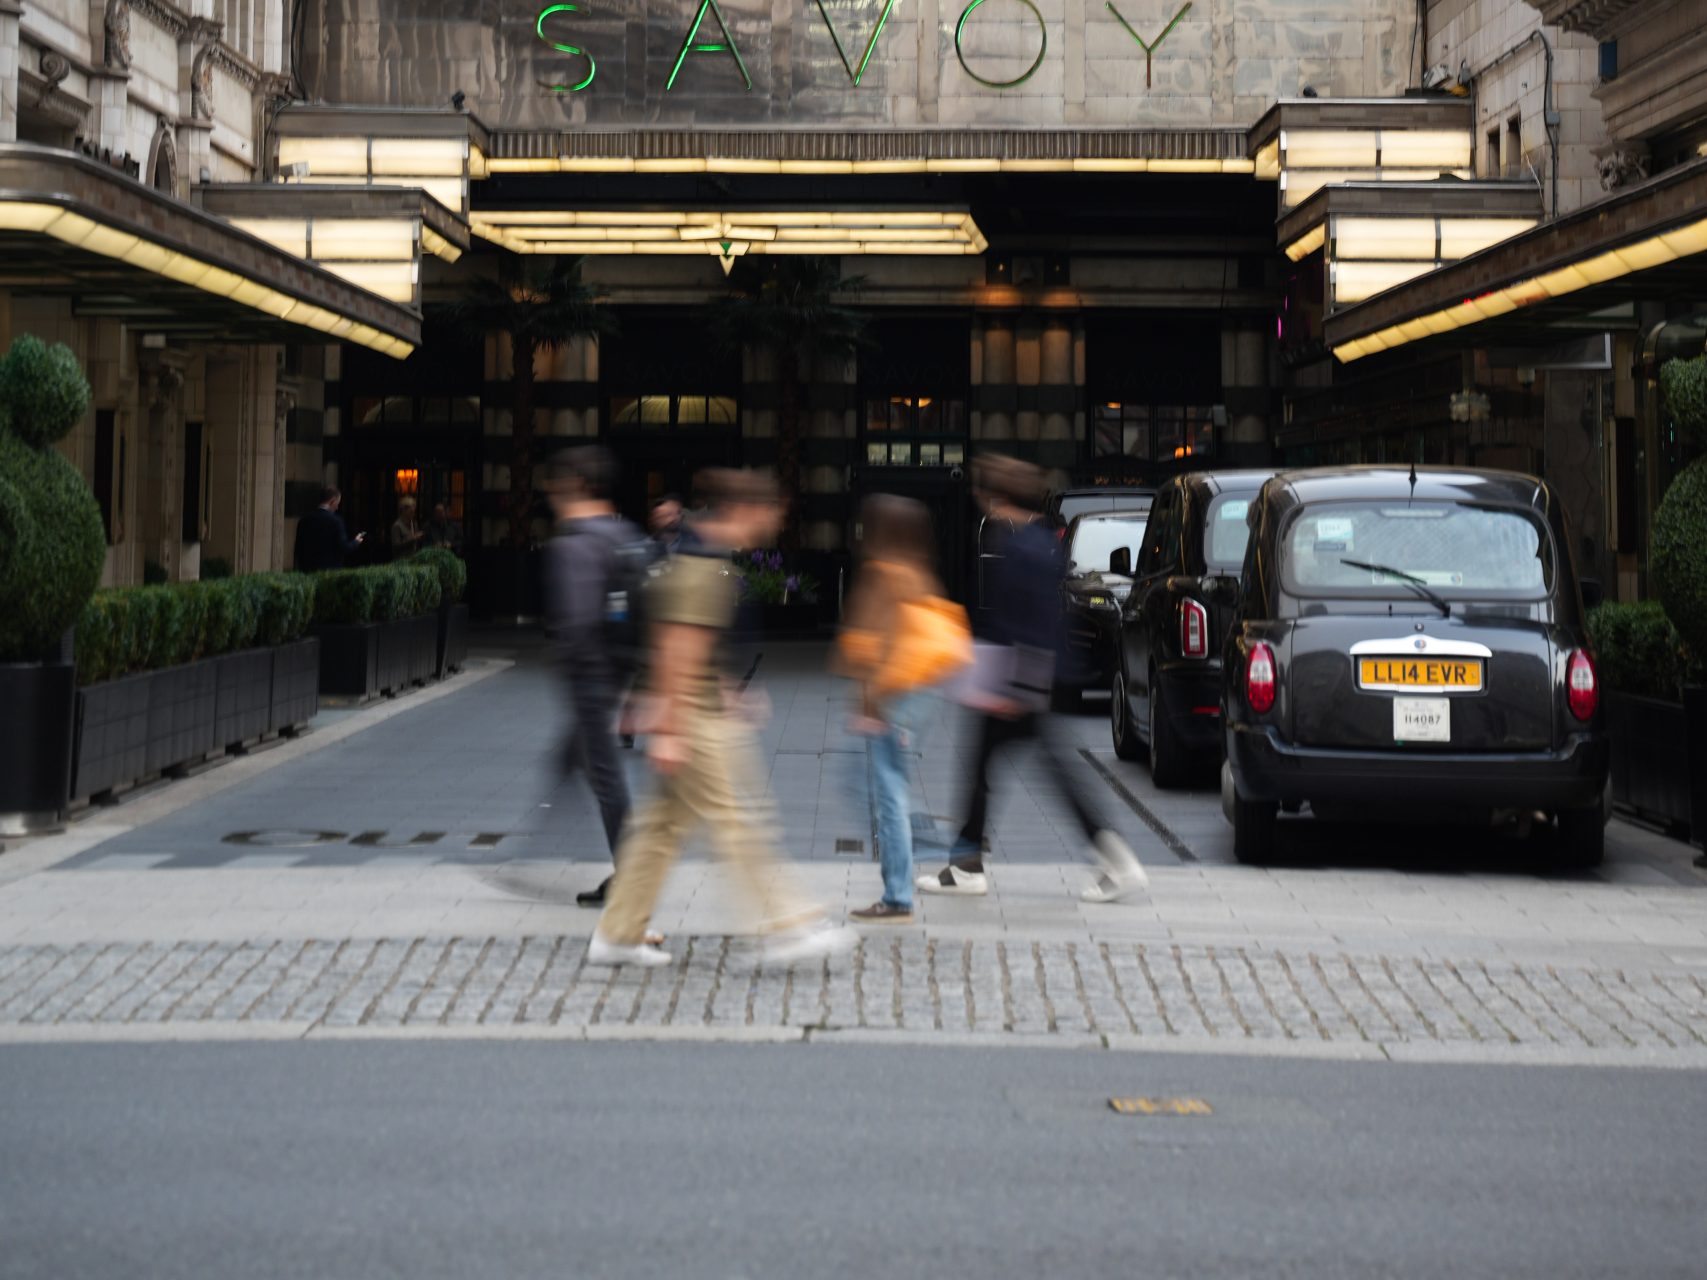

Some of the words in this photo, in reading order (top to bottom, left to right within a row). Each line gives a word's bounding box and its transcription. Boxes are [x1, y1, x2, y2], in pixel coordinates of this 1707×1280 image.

[1374, 662, 1419, 683] LL14
[1426, 663, 1467, 684] EVR
[220, 828, 529, 850] OUT
